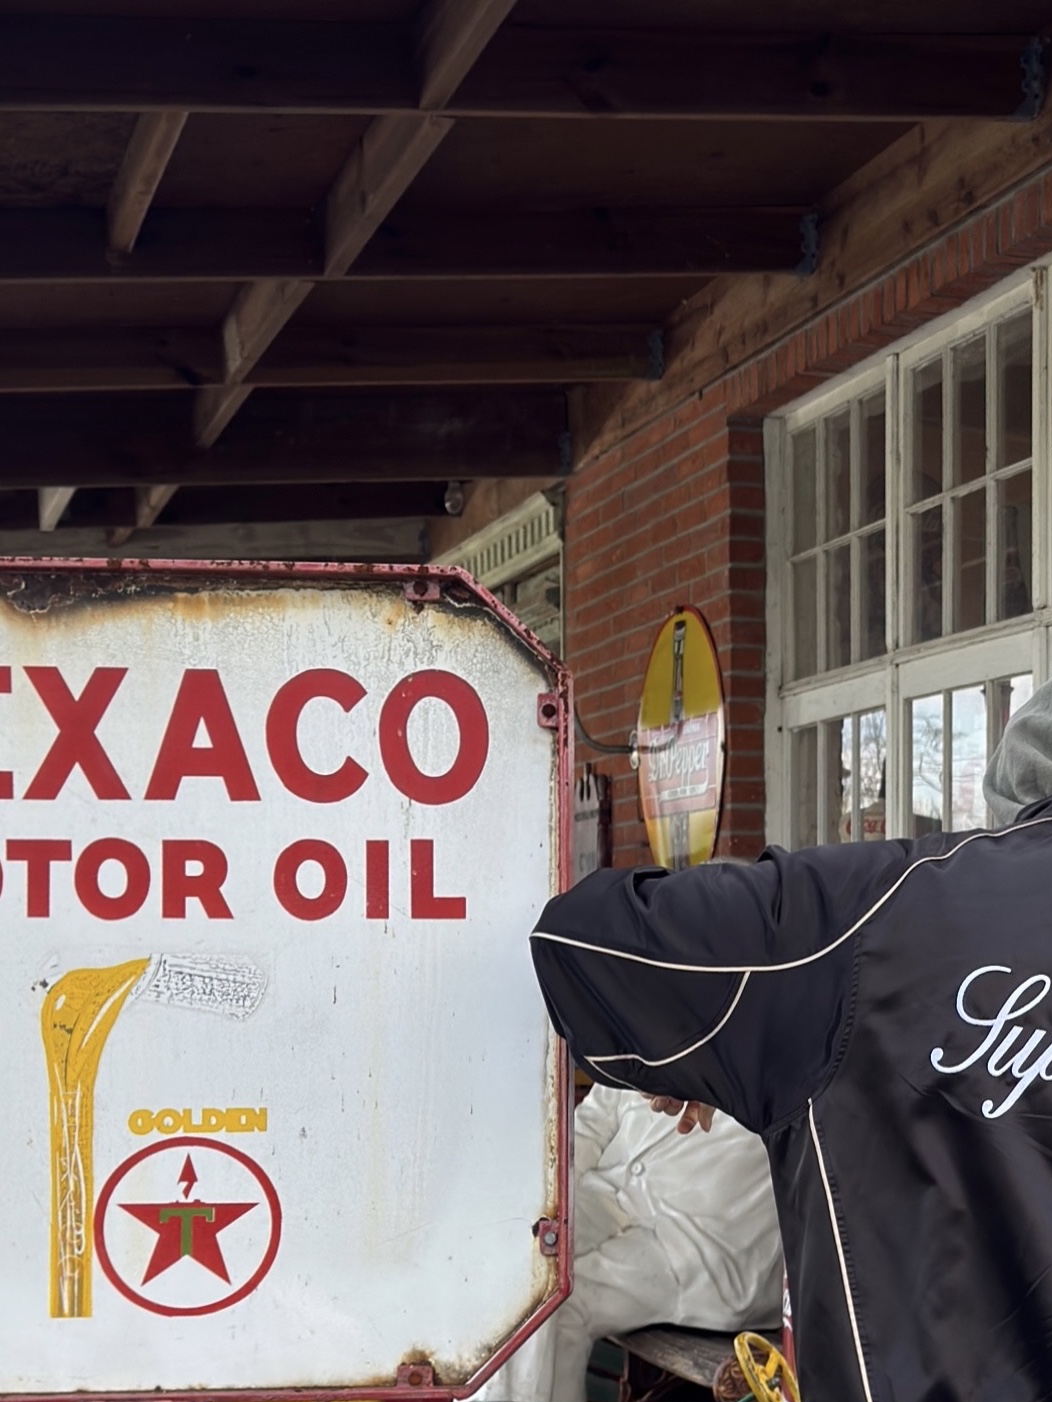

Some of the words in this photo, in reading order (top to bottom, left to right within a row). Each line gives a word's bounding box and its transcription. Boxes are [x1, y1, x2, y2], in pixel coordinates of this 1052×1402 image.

[0, 666, 490, 806] XACO
[0, 837, 234, 922] TOR
[273, 838, 467, 923] OIL
[128, 1107, 268, 1135] GOLDEN
